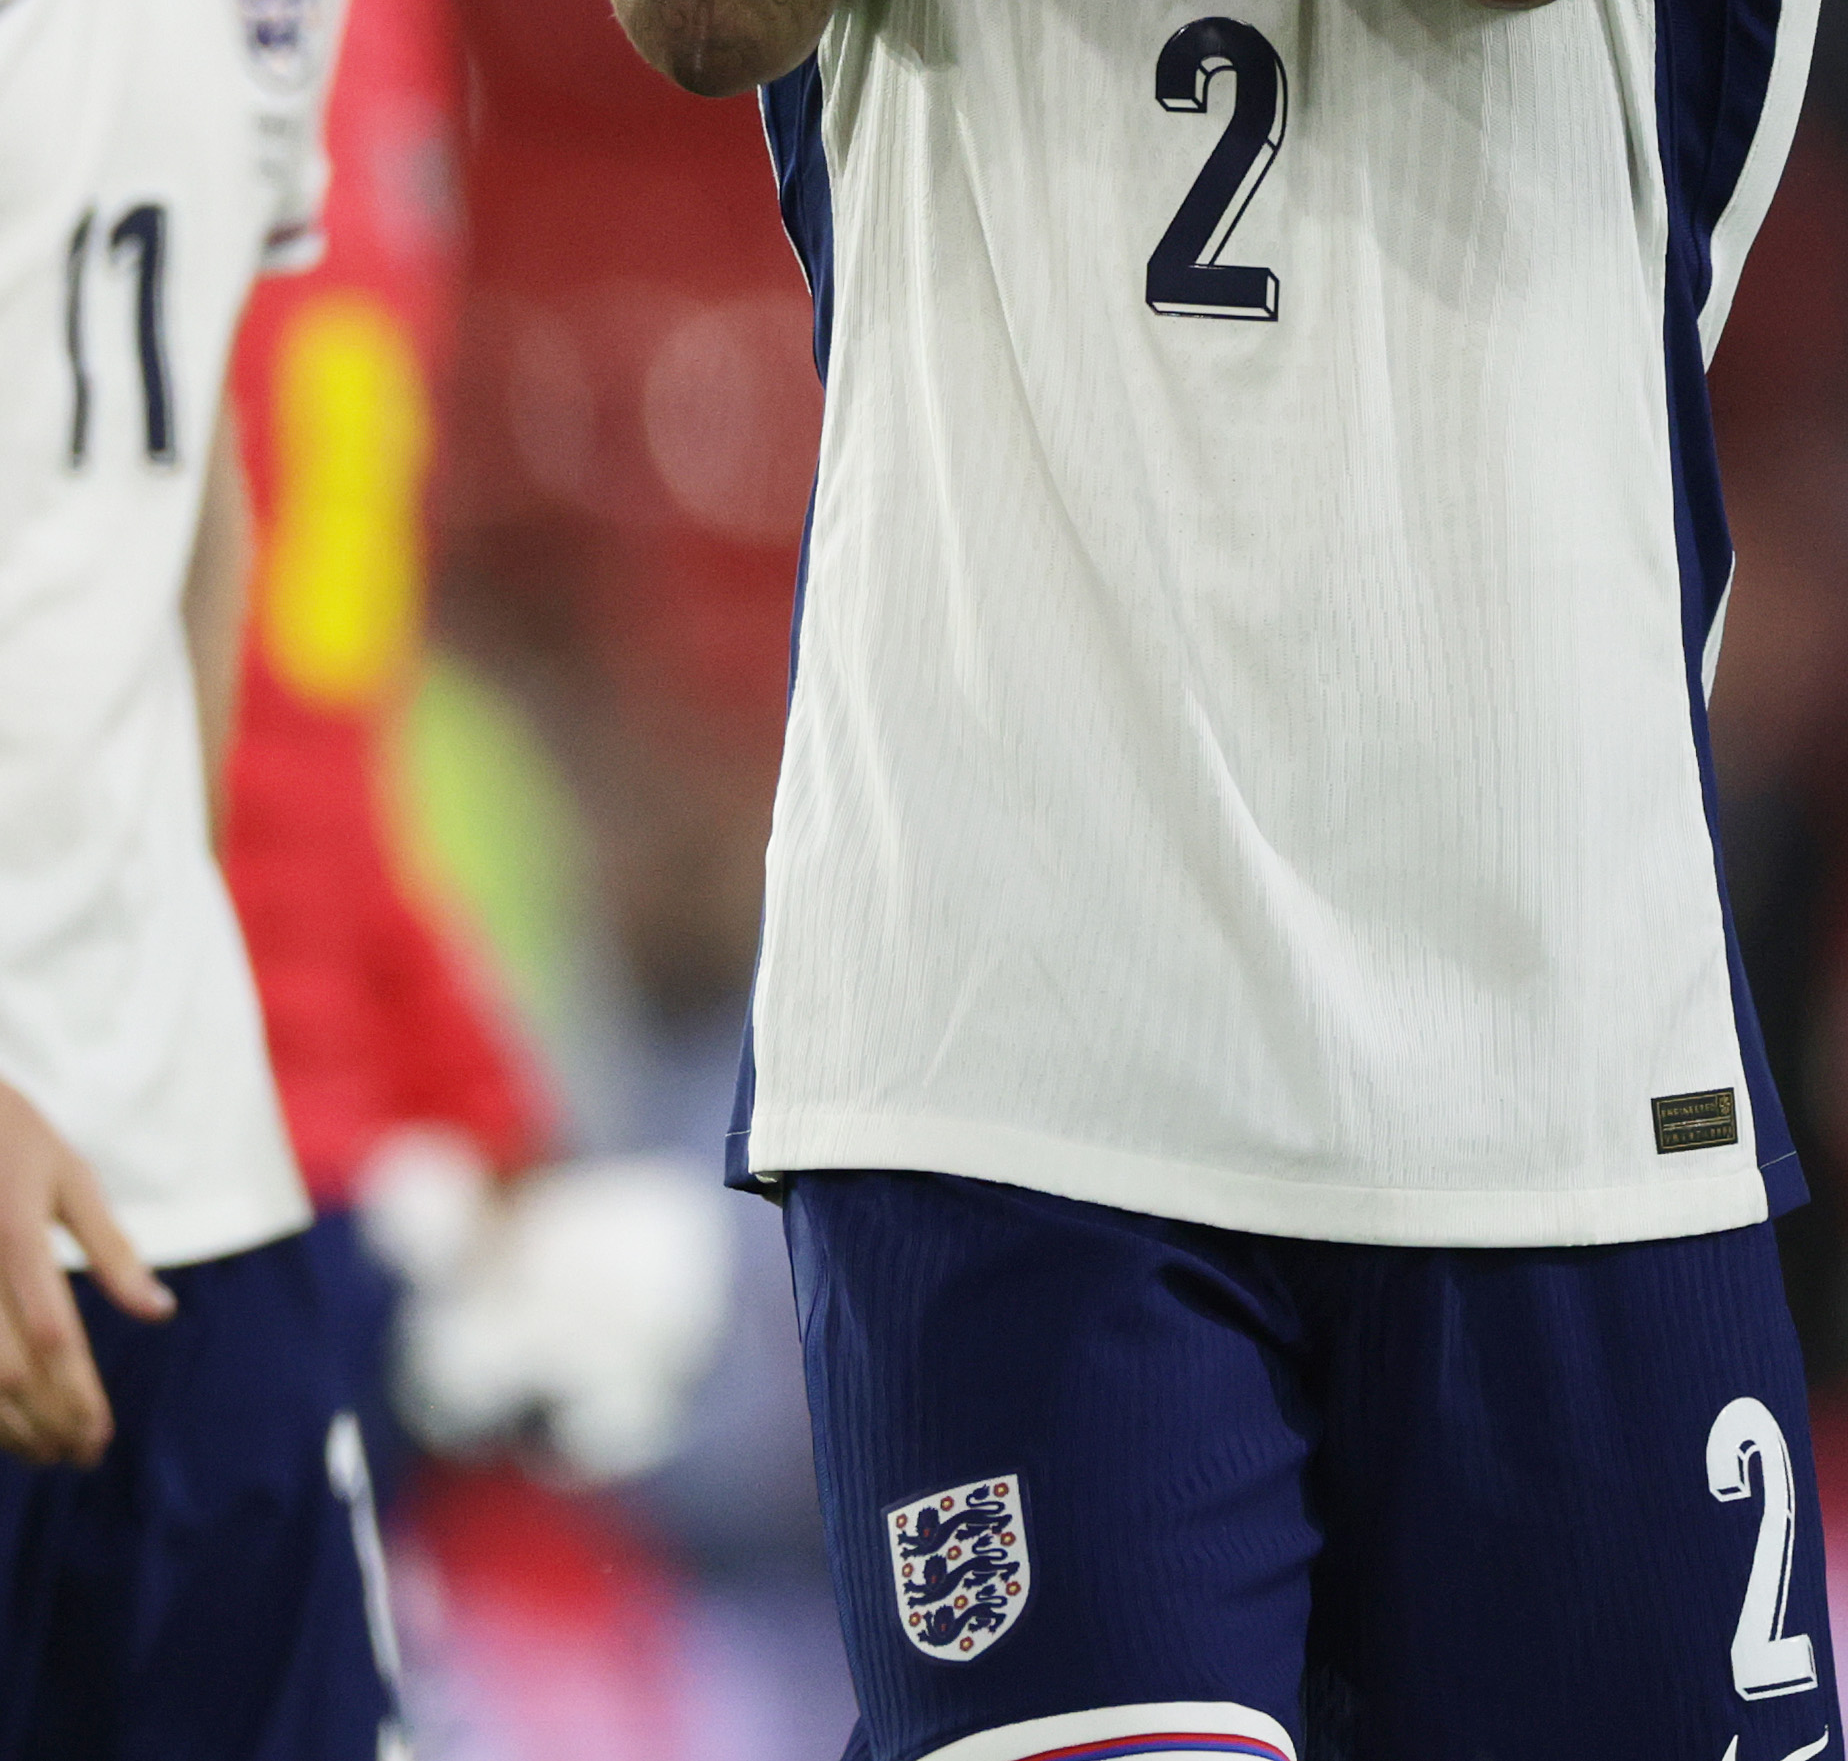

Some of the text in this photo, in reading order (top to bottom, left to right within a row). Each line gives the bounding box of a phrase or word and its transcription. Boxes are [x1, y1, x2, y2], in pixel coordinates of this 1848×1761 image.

[1146, 16, 1289, 321] 2
[68, 203, 176, 467] 11
[1706, 1396, 1818, 1702] 2
